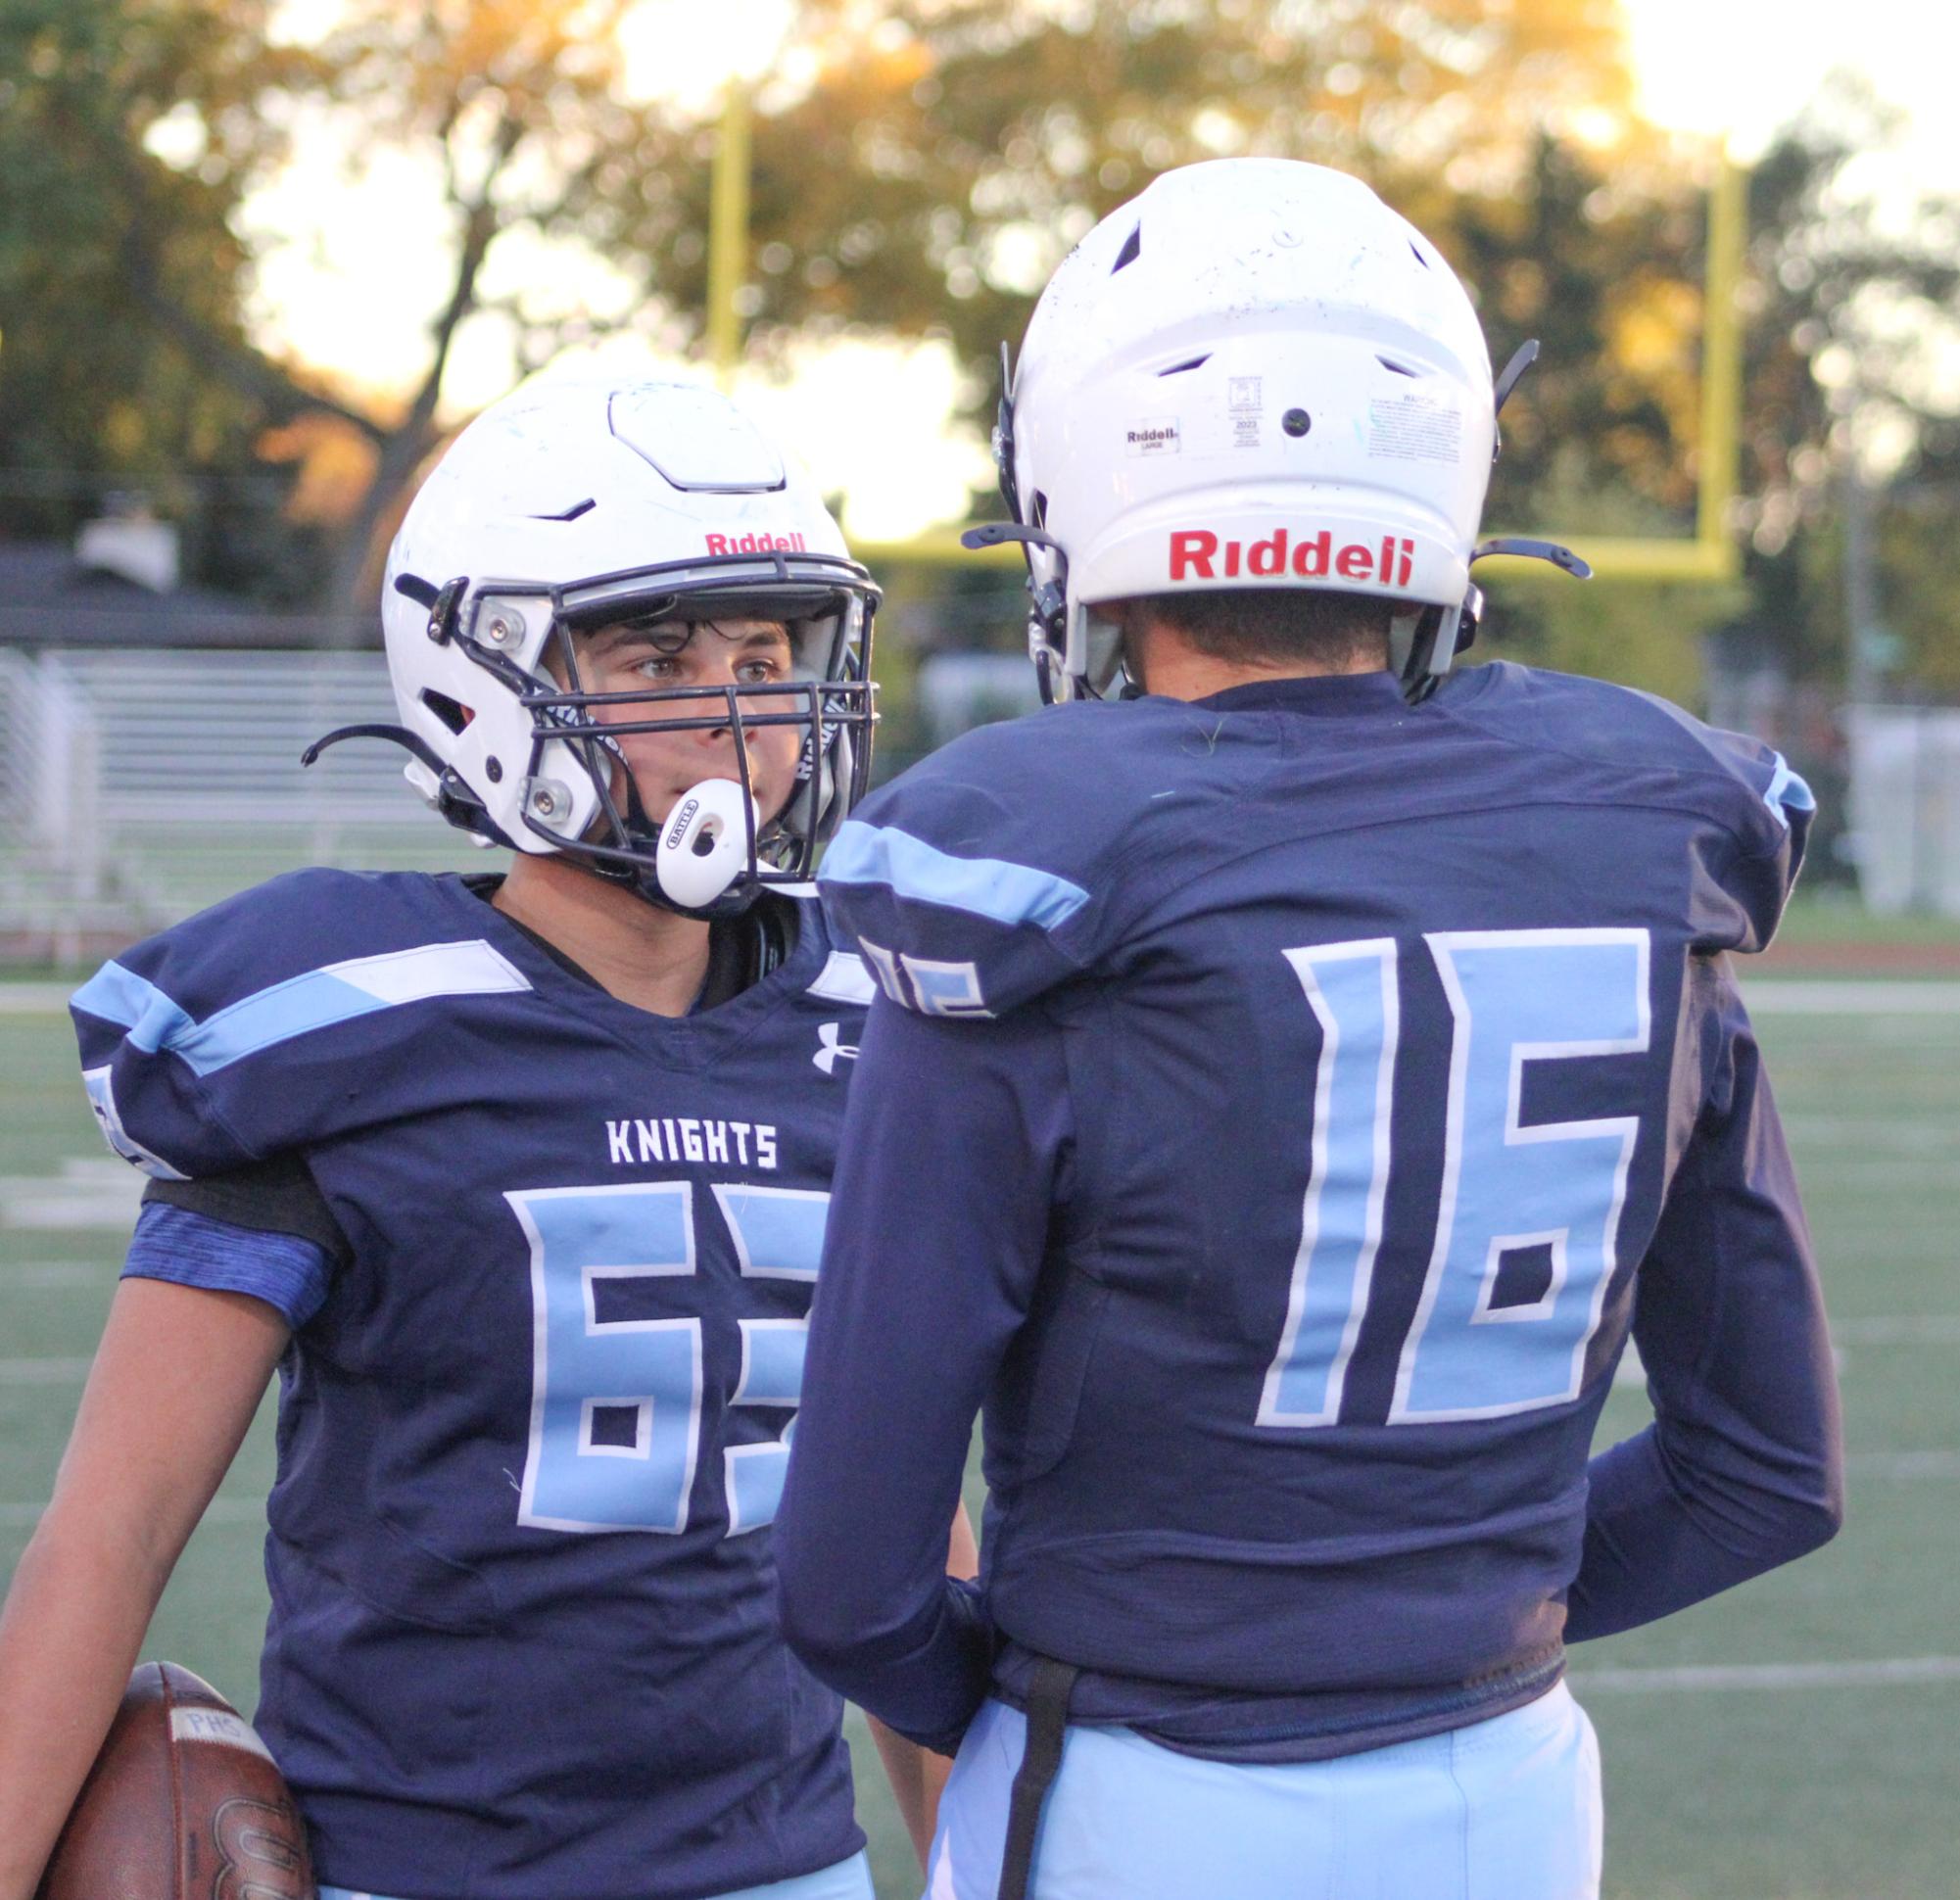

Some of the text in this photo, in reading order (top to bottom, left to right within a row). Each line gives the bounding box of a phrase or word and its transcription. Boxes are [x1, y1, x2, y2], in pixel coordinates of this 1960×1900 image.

[1127, 427, 1174, 444] Riddell
[704, 532, 807, 557] Riddell
[1169, 528, 1414, 589] Riddell
[669, 802, 696, 844] BATTLE
[605, 1117, 778, 1169] KNIGHTS
[1254, 926, 1651, 1427] 16
[186, 1713, 242, 1738] PHS
